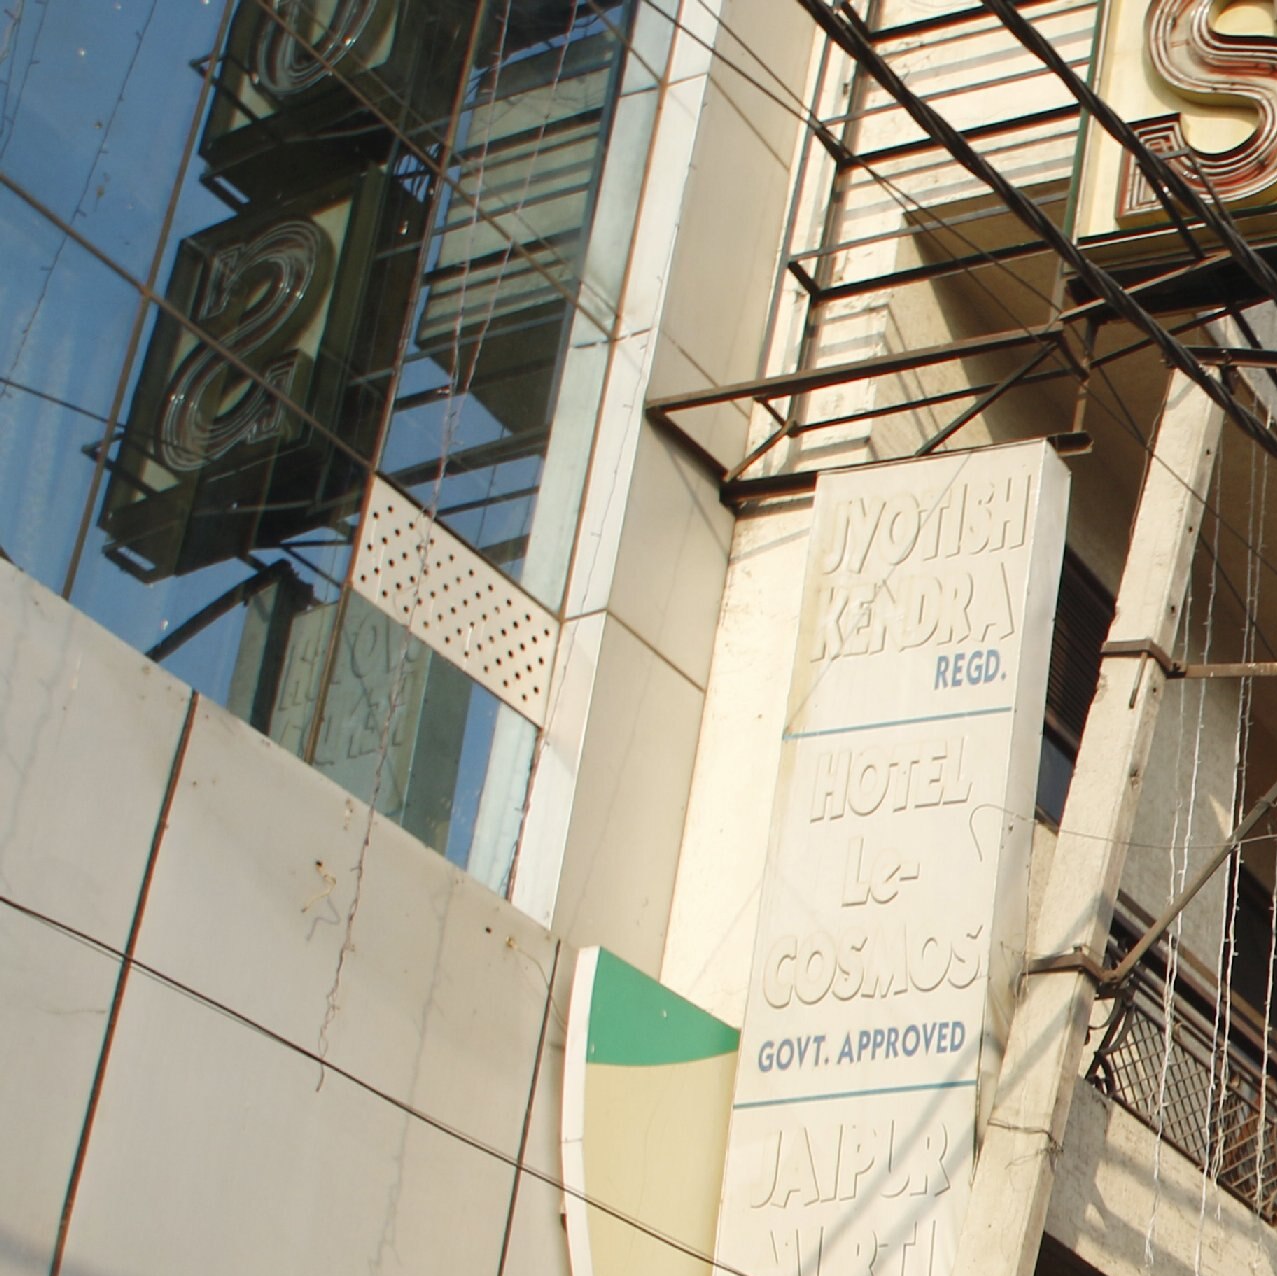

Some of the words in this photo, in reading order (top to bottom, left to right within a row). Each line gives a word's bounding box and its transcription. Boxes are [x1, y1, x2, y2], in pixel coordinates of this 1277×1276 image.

[823, 473, 1032, 576] JYOTISH
[809, 562, 1015, 663] KENDRA
[934, 648, 1007, 690] REGD.
[809, 735, 973, 823] HOTEL
[764, 923, 985, 1010] COSMOS
[757, 1033, 830, 1074] GOVT.
[837, 1020, 966, 1066] APPROVED
[750, 1116, 951, 1209] JAIPUR
